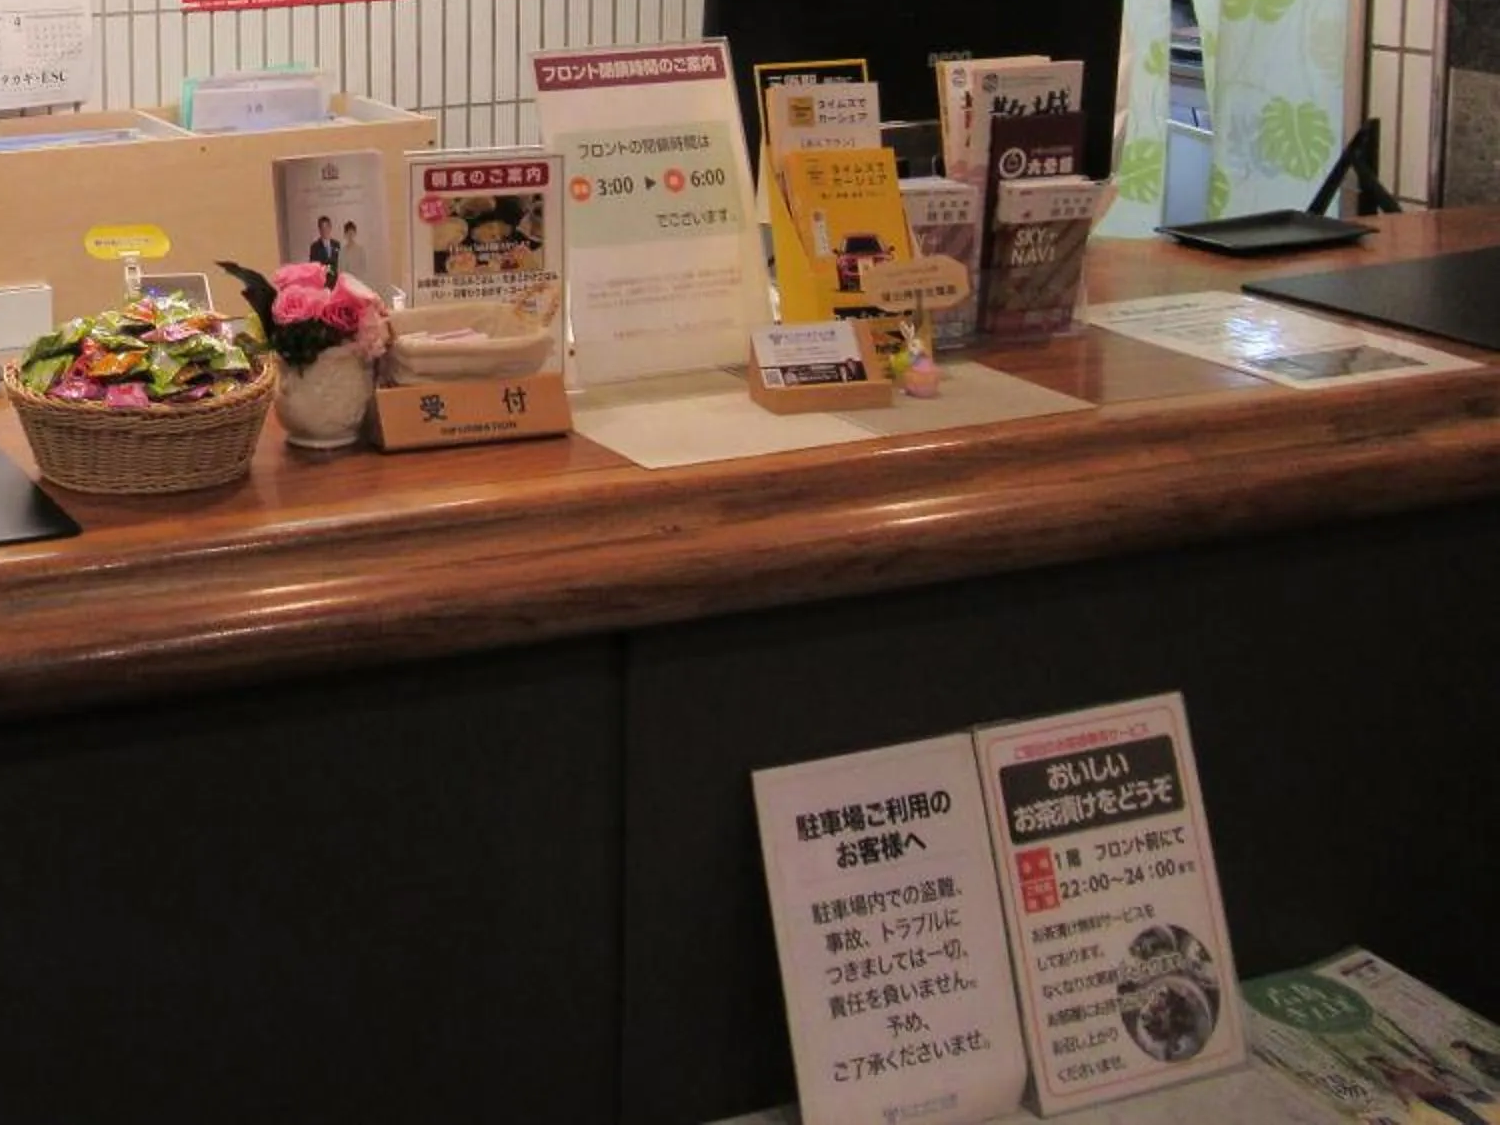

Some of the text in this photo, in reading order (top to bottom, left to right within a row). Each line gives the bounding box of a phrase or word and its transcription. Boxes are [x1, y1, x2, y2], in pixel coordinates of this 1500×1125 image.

[430, 165, 542, 189] 朝食のご案内
[597, 168, 726, 196] 3:00 6:00
[419, 385, 527, 422] 受付
[1046, 752, 1131, 791] おいしい
[795, 789, 952, 842] 駐車場ご利用の
[835, 832, 928, 869] お客様へ
[825, 908, 962, 954] 事故、トラブルに
